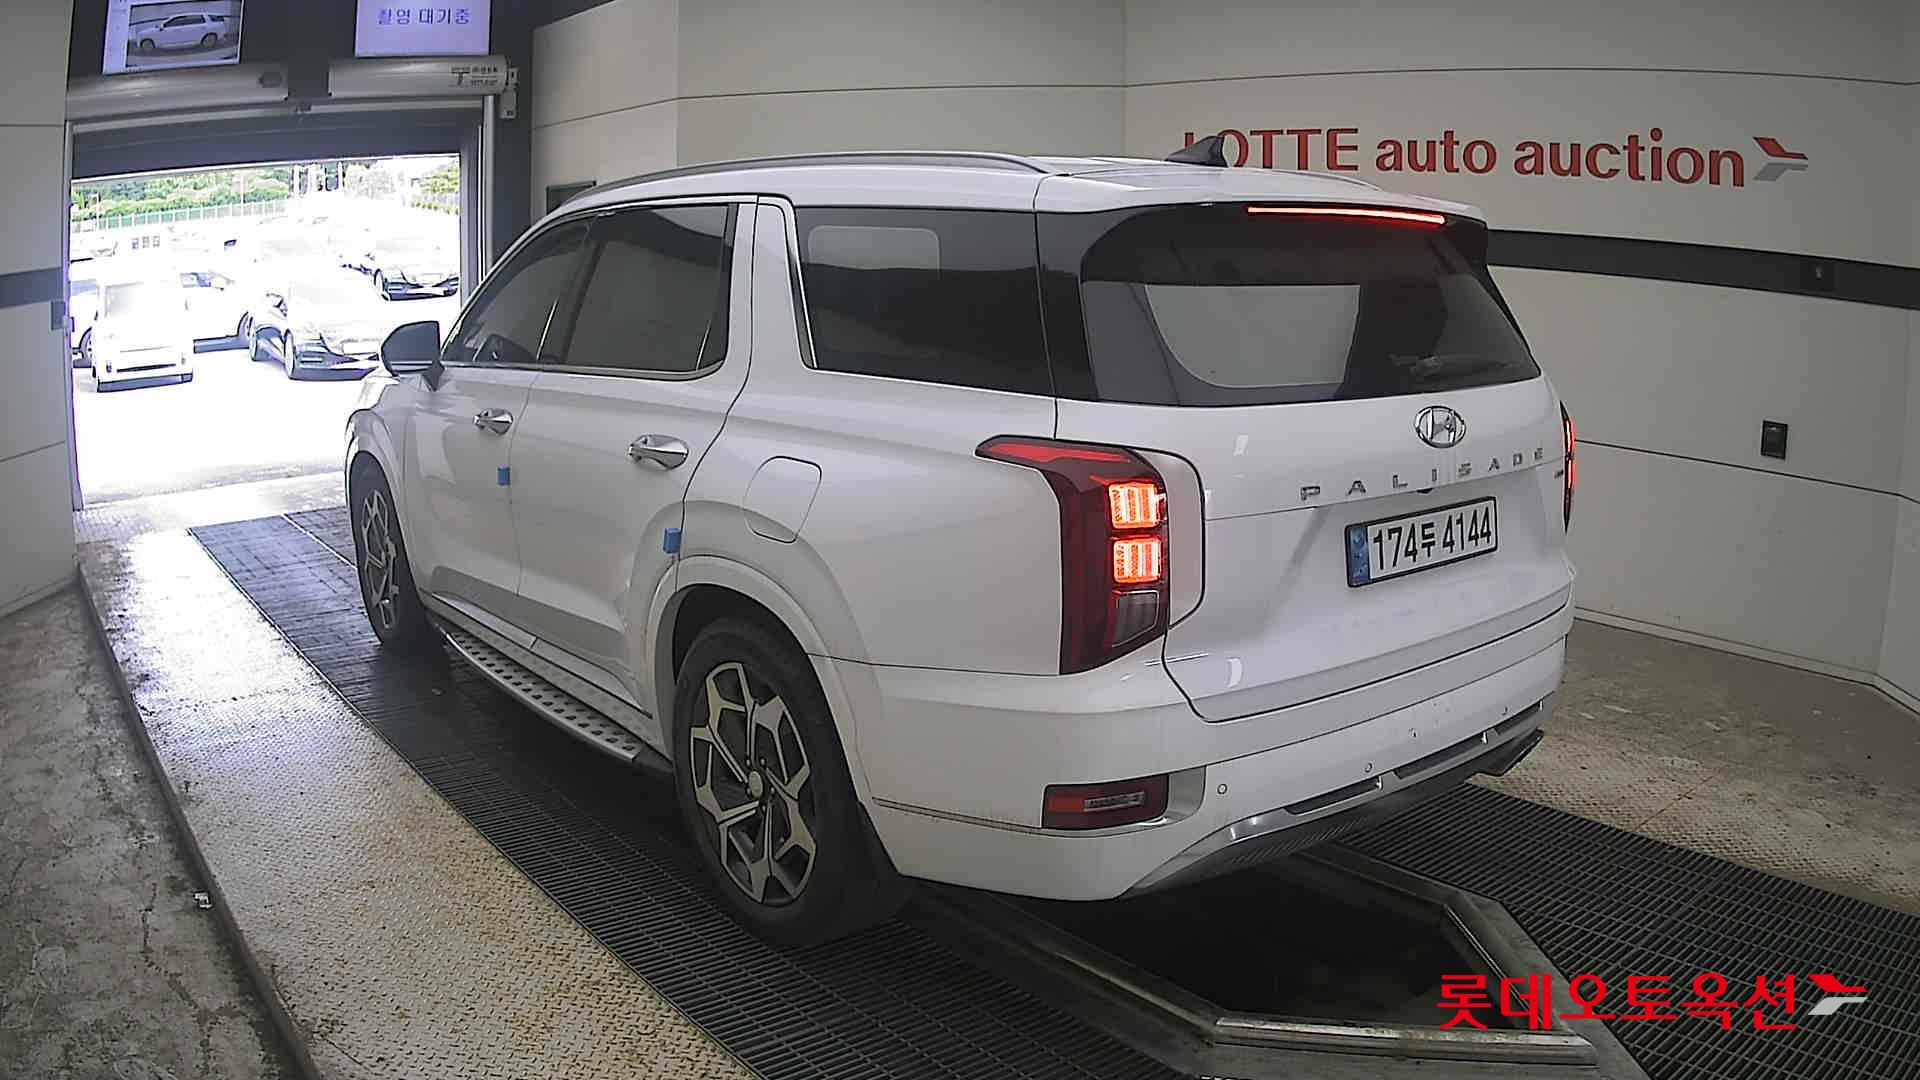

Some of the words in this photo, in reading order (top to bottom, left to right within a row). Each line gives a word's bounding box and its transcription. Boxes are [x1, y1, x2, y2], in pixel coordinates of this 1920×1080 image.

[419, 7, 471, 25] 대기중
[1376, 129, 1497, 174] auto
[1514, 127, 1745, 187] auction
[1300, 447, 1544, 501] PALISADE
